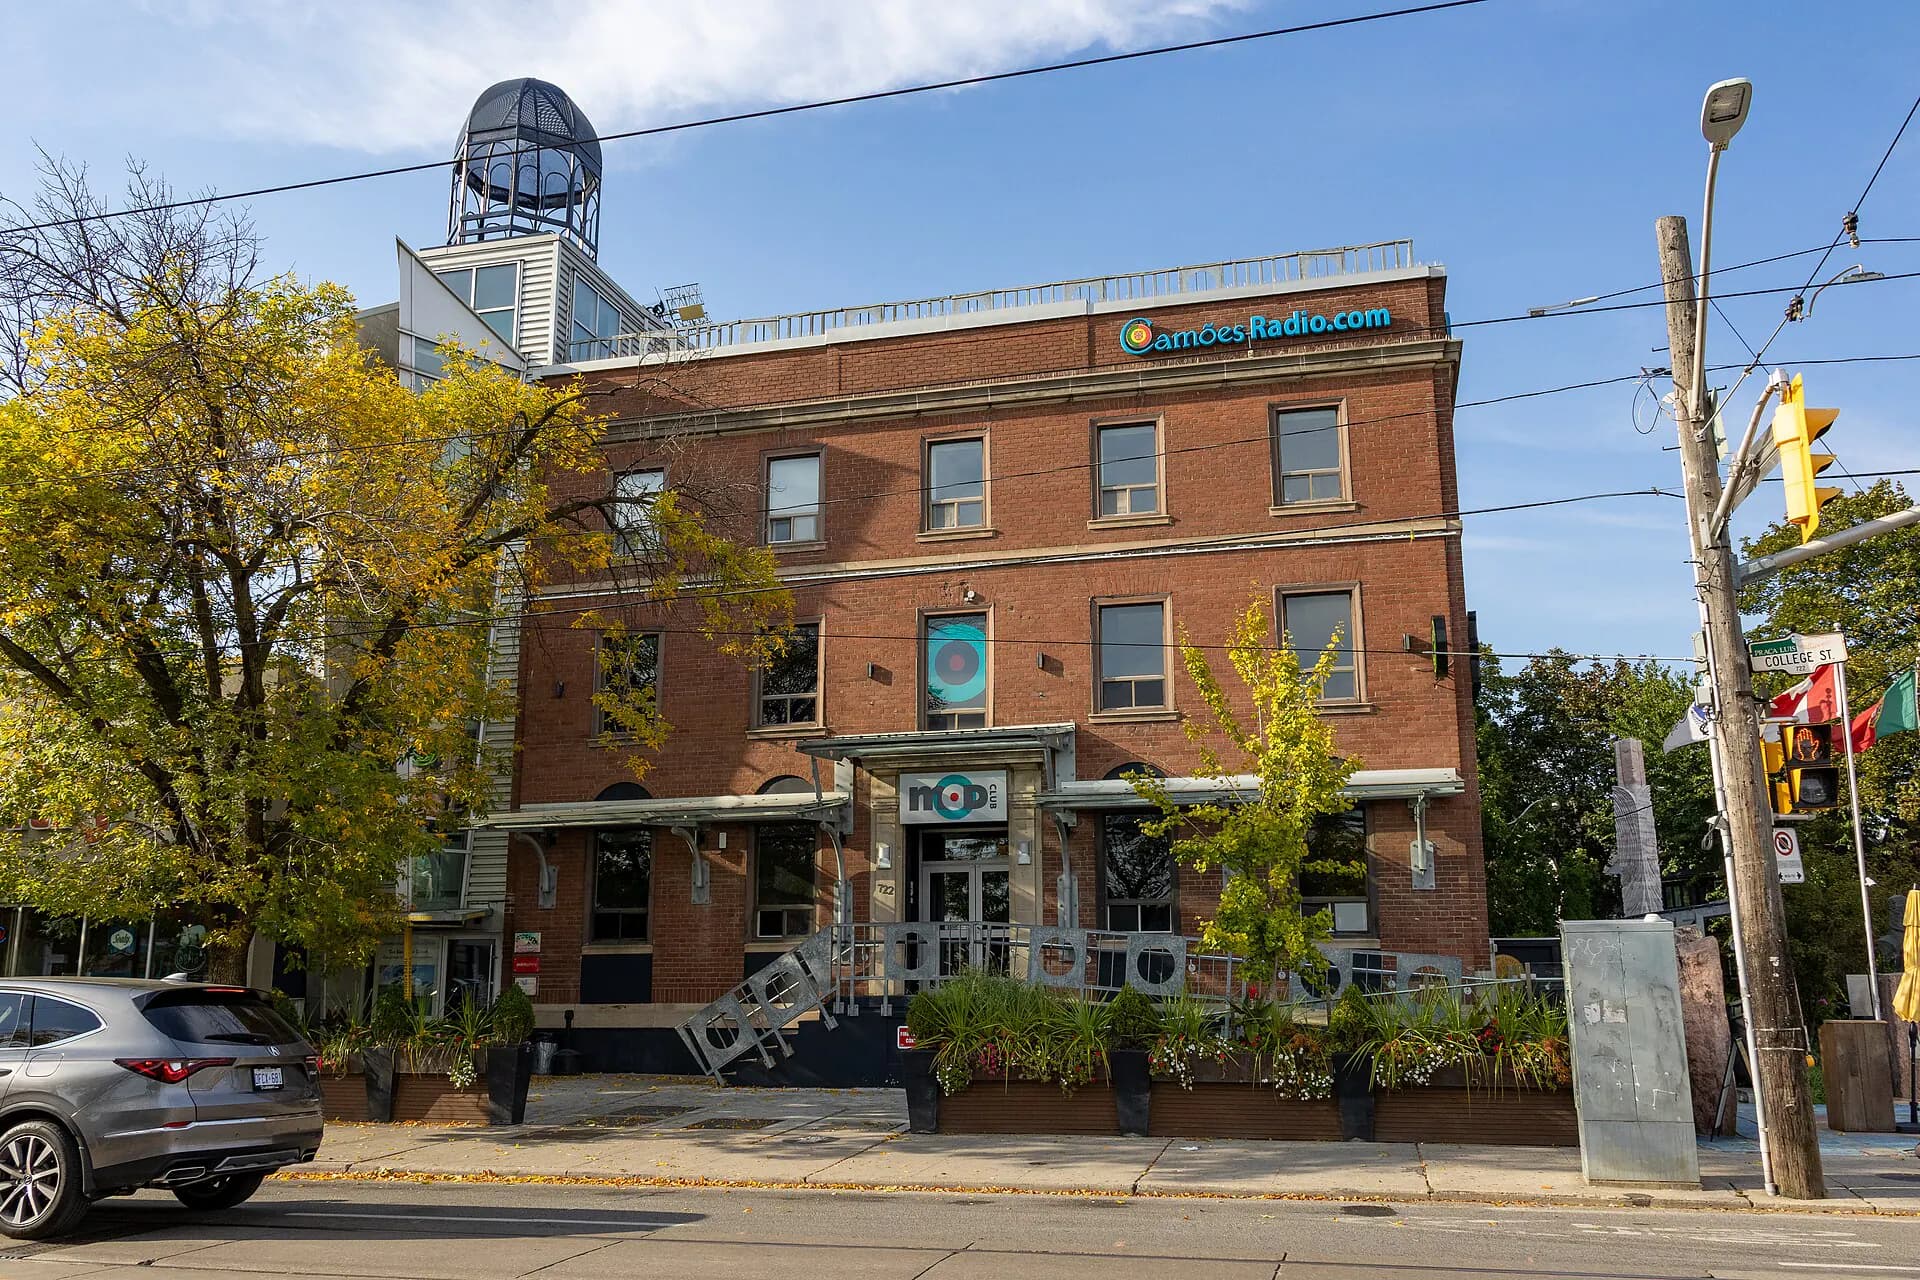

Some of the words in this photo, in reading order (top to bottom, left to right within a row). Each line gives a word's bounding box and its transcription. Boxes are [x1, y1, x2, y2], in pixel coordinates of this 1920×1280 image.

[1765, 651, 1814, 667] COLLEGE
[1819, 649, 1835, 660] ST.
[989, 783, 997, 809] CLUB
[878, 884, 894, 895] 722
